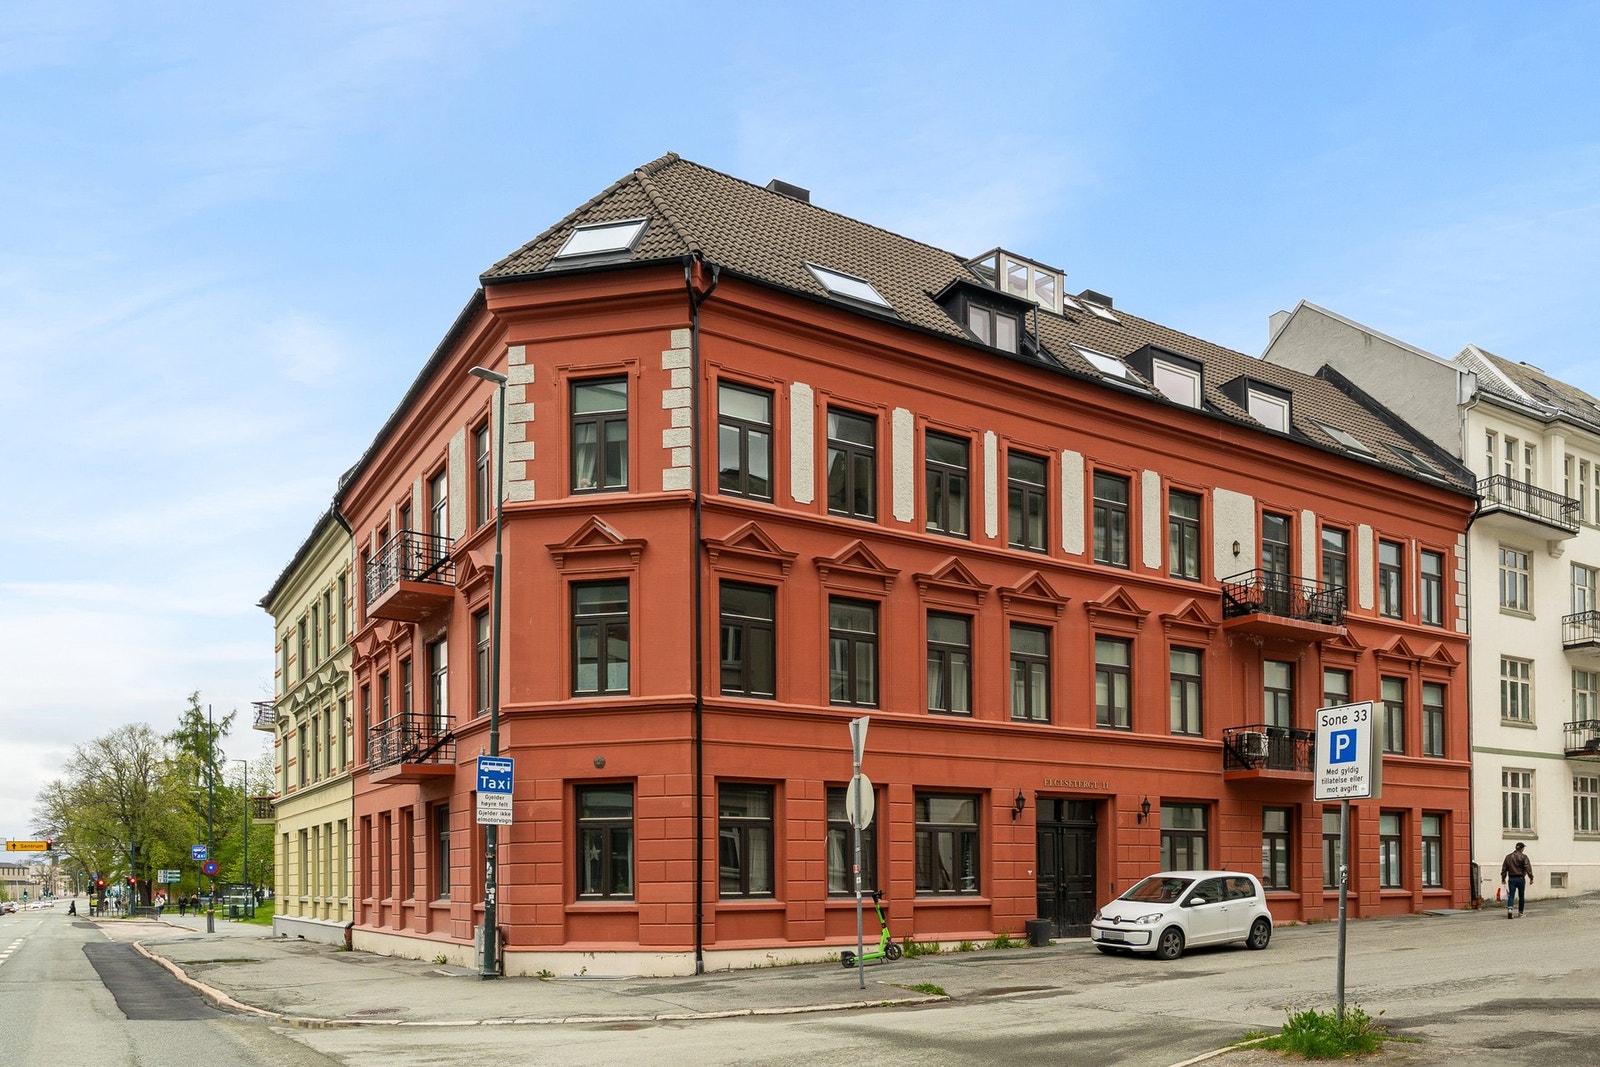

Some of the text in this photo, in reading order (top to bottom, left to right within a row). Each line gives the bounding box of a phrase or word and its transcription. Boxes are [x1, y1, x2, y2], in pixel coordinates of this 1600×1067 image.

[1321, 709, 1368, 727] Sone 33
[1335, 733, 1351, 760] P
[1340, 766, 1360, 775] gyldig
[480, 775, 511, 790] Taxi
[1321, 776, 1348, 785] tillatelse
[1340, 784, 1358, 794] avgift
[478, 809, 498, 817] Gjelder
[477, 816, 512, 824] elmotorvogn
